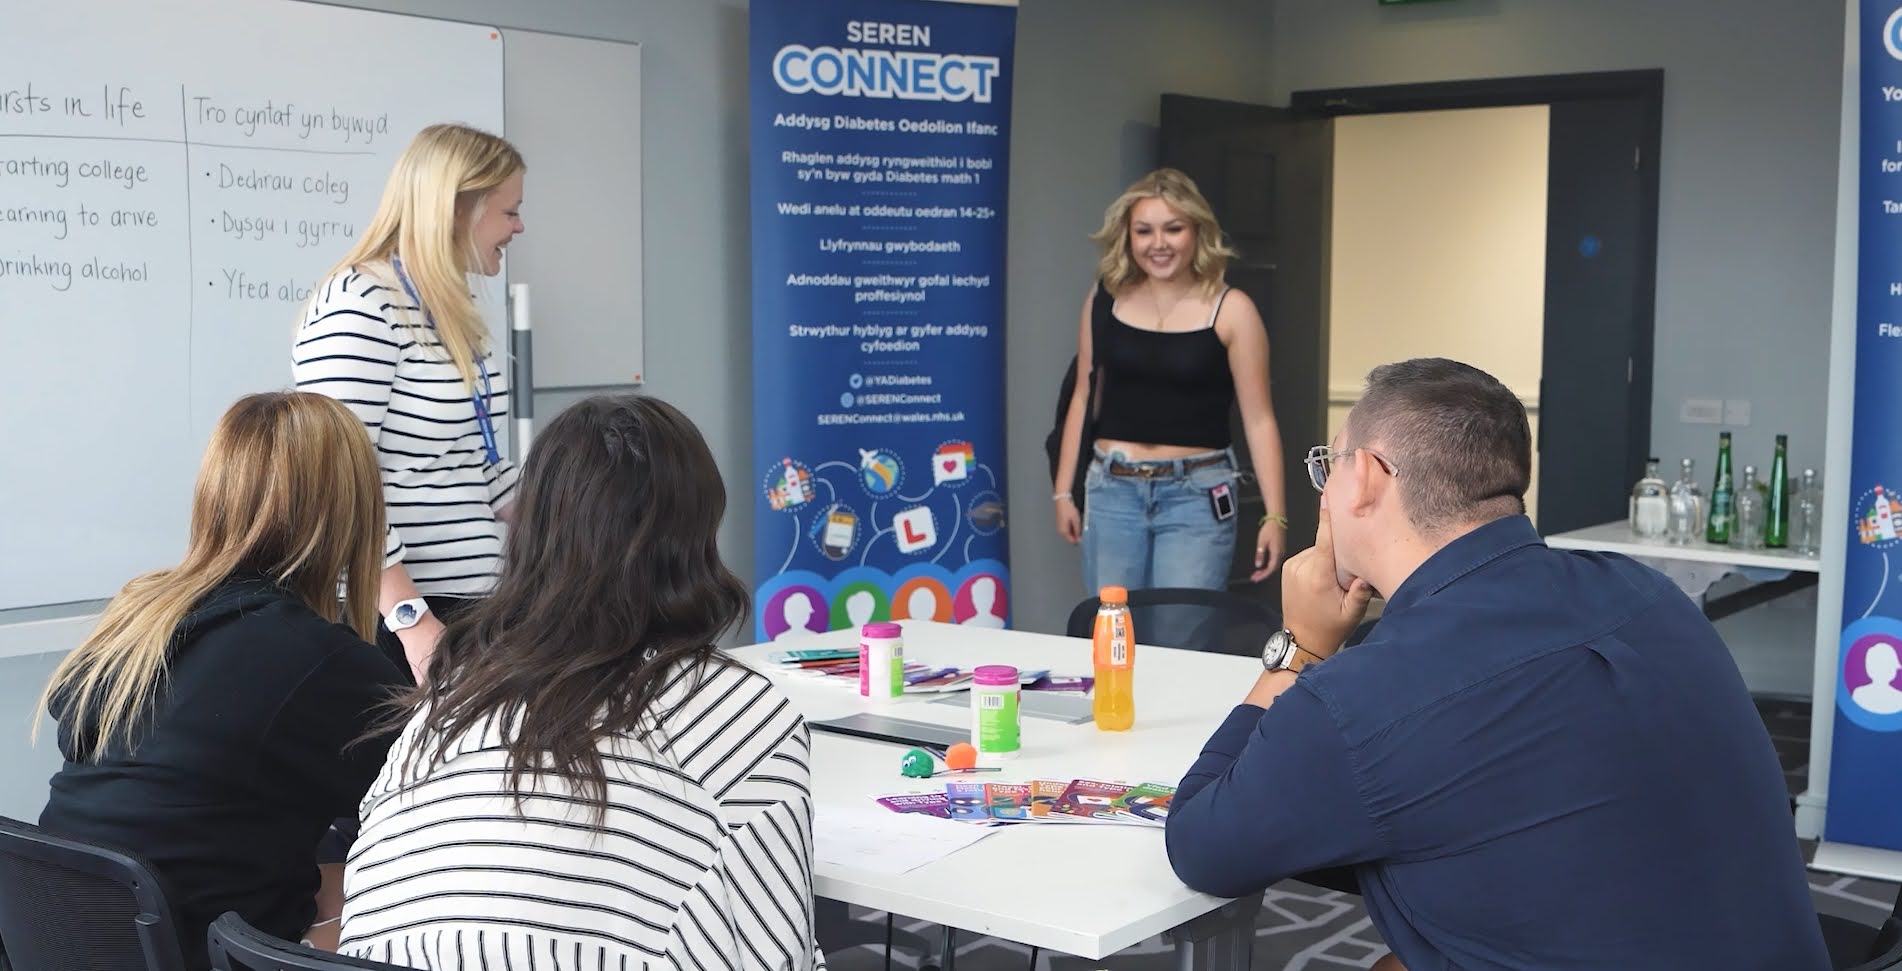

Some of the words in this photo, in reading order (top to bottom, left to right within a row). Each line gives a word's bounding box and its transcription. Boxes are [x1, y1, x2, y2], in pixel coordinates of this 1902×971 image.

[847, 21, 931, 46] SEREN
[772, 45, 1000, 103] CONNECT
[65, 96, 92, 117] in
[105, 84, 146, 126] life
[193, 96, 226, 125] Tro
[235, 100, 295, 137] cyntaf
[299, 113, 323, 140] yn
[332, 106, 388, 144] bywyd
[774, 113, 830, 131] Addysg
[834, 115, 895, 131] Diabetes
[898, 118, 962, 134] Oedolion
[967, 121, 998, 136] Ifanc
[782, 151, 833, 166] Rhaglen
[836, 153, 880, 168] addysg
[78, 159, 148, 189] college
[218, 163, 293, 190] Dechrau
[303, 171, 349, 204] coleg
[825, 169, 850, 182] byw
[853, 170, 883, 184] gyda
[886, 170, 939, 184] Diabetes
[941, 172, 972, 184] math
[974, 173, 980, 184] 1
[77, 203, 100, 226] to
[777, 202, 811, 215] Wedi
[814, 203, 846, 216] anelu
[849, 204, 860, 216] at
[863, 204, 912, 217] oddeutu
[915, 205, 957, 218] oedran
[223, 210, 275, 241] Dysgu
[296, 219, 353, 248] gyrru
[885, 239, 961, 254] gwybodaeth
[81, 256, 148, 282] alcohol
[787, 273, 851, 287] Adnoddau
[854, 274, 916, 288] gweithwyr
[918, 274, 950, 288] gofal
[789, 324, 850, 338] Strwythur
[896, 326, 908, 336] ar
[910, 324, 942, 338] gyfer
[945, 324, 988, 338] addysg
[1879, 323, 1902, 337] Fle
[904, 519, 926, 544] L
